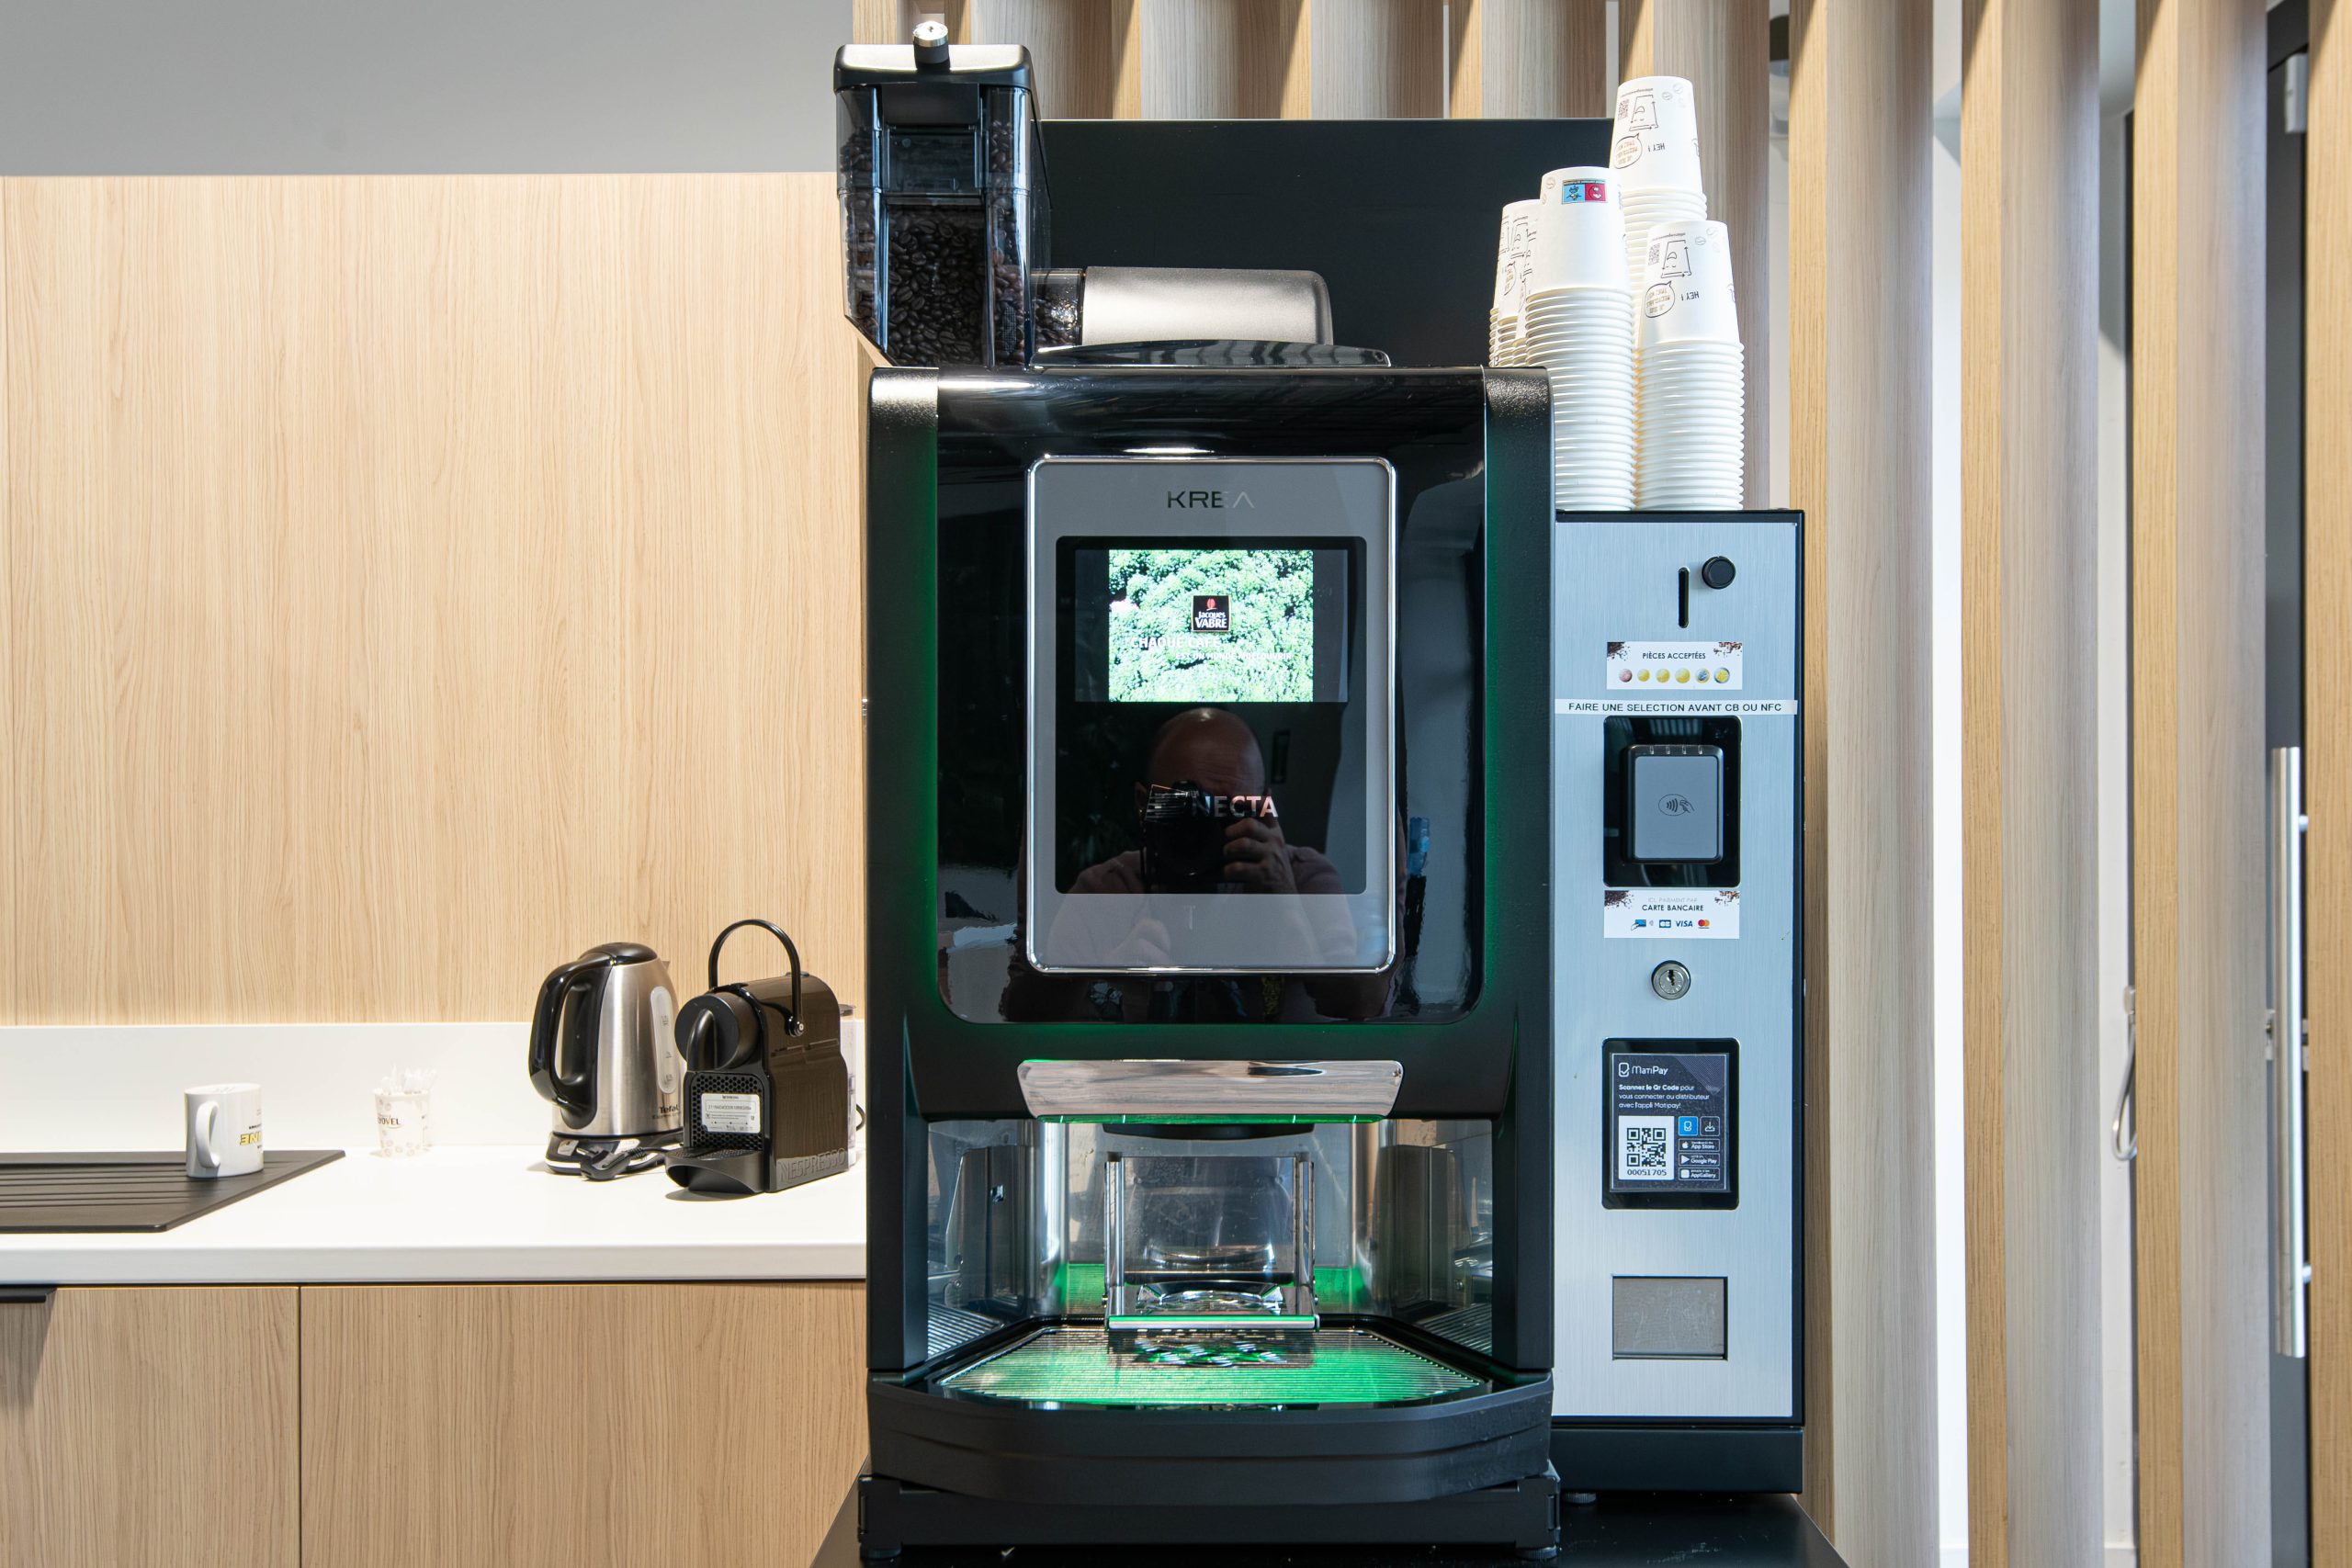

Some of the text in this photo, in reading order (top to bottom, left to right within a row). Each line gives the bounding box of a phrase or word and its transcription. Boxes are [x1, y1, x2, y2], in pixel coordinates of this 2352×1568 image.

[1686, 291, 1700, 300] HEY
[1167, 491, 1255, 508] KREA
[1198, 611, 1227, 619] Jacques
[1194, 617, 1227, 628] VABRE
[1642, 650, 1706, 660] PIÈCES ACCEPTÉES
[1568, 703, 1782, 713] FAIRE UNE SELECTION AVANT CB OU NFC
[1192, 795, 1279, 818] NECTA
[660, 1104, 678, 1113] Tefal
[777, 1147, 846, 1183] NESPRESSO
